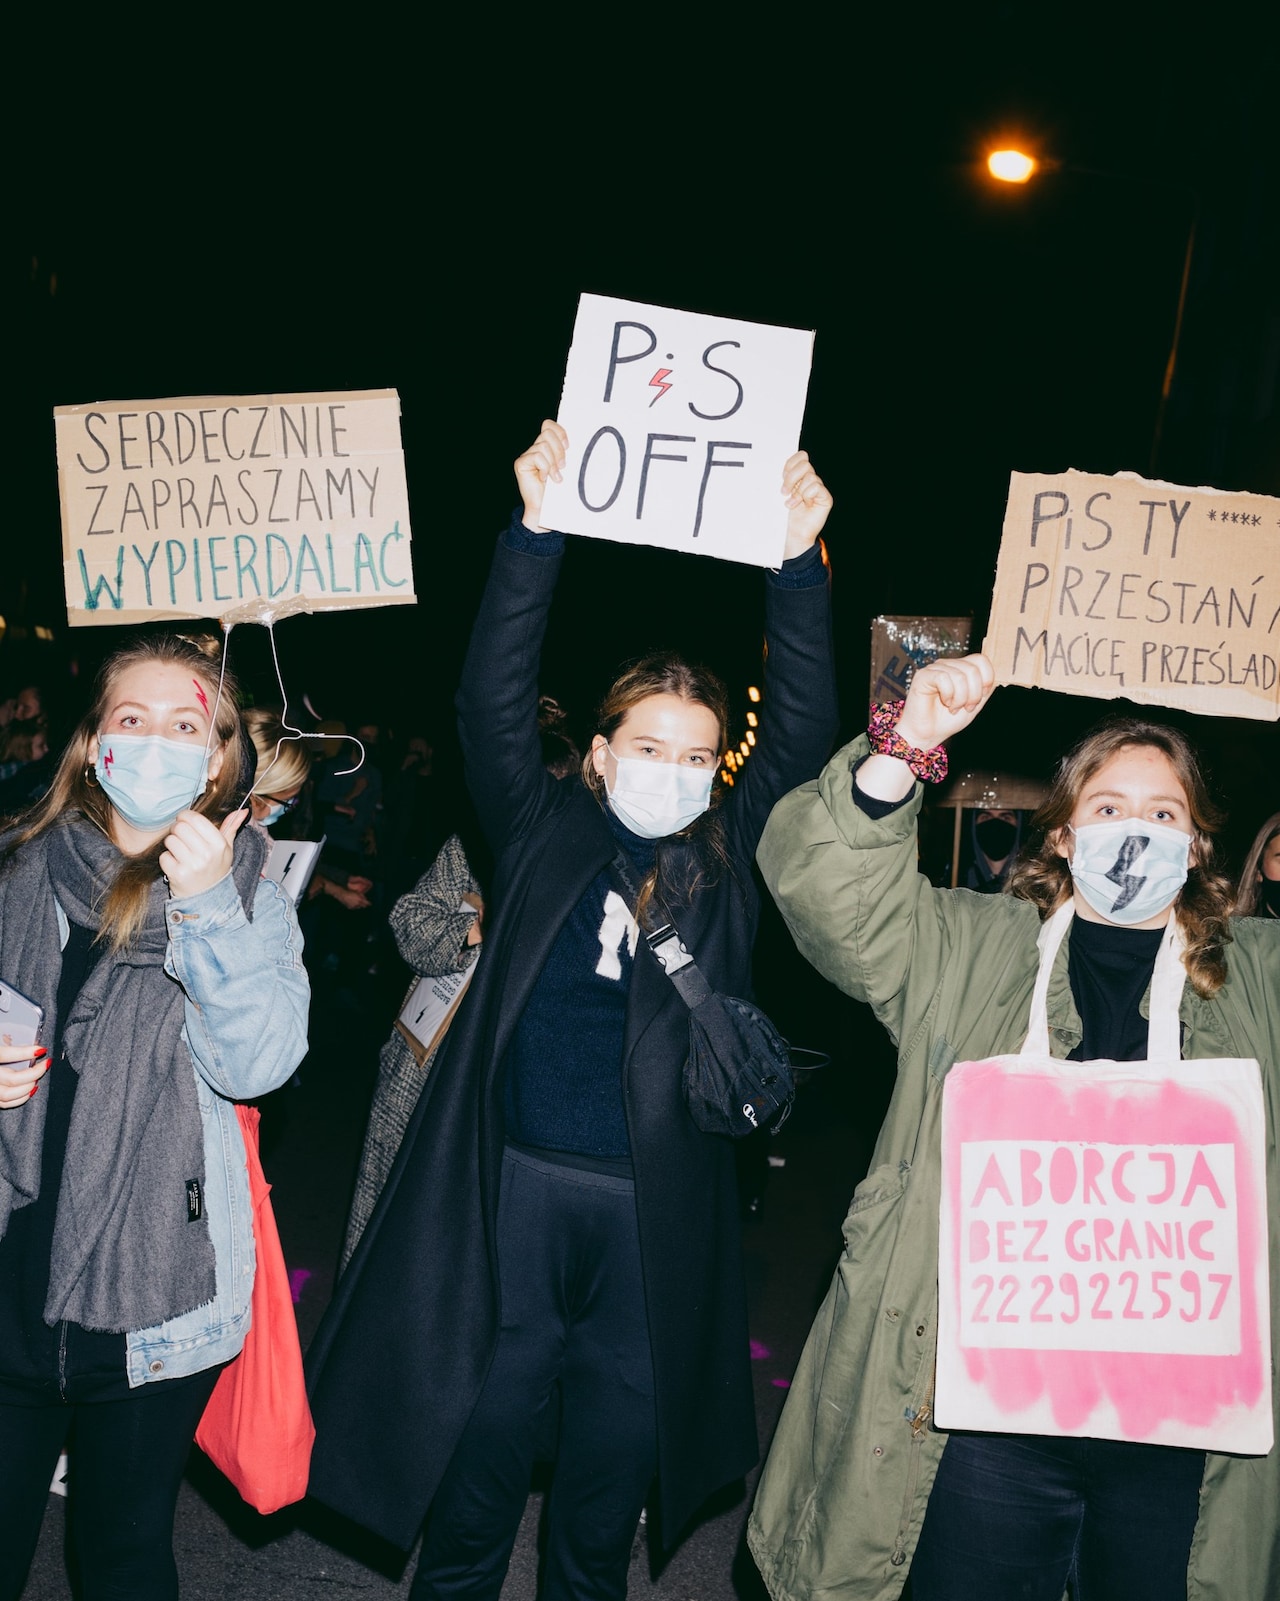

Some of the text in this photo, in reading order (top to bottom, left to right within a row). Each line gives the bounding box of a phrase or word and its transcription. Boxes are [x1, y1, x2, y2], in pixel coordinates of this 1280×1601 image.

[77, 405, 350, 474] SERDECZNIE
[86, 466, 379, 536] ZAPRASZAMY
[578, 425, 752, 537] OFF
[1030, 491, 1112, 551] PiS
[1139, 499, 1191, 558] TY
[77, 520, 408, 610] WYPIERDALAĆ
[1020, 562, 1265, 628] PRZESTAŃ
[1142, 641, 1277, 690] PRZEŚLAD
[971, 1147, 1227, 1209] ABORCJA
[969, 1218, 1215, 1263] BEZ GRANIC
[971, 1271, 1232, 1324] 222922597
